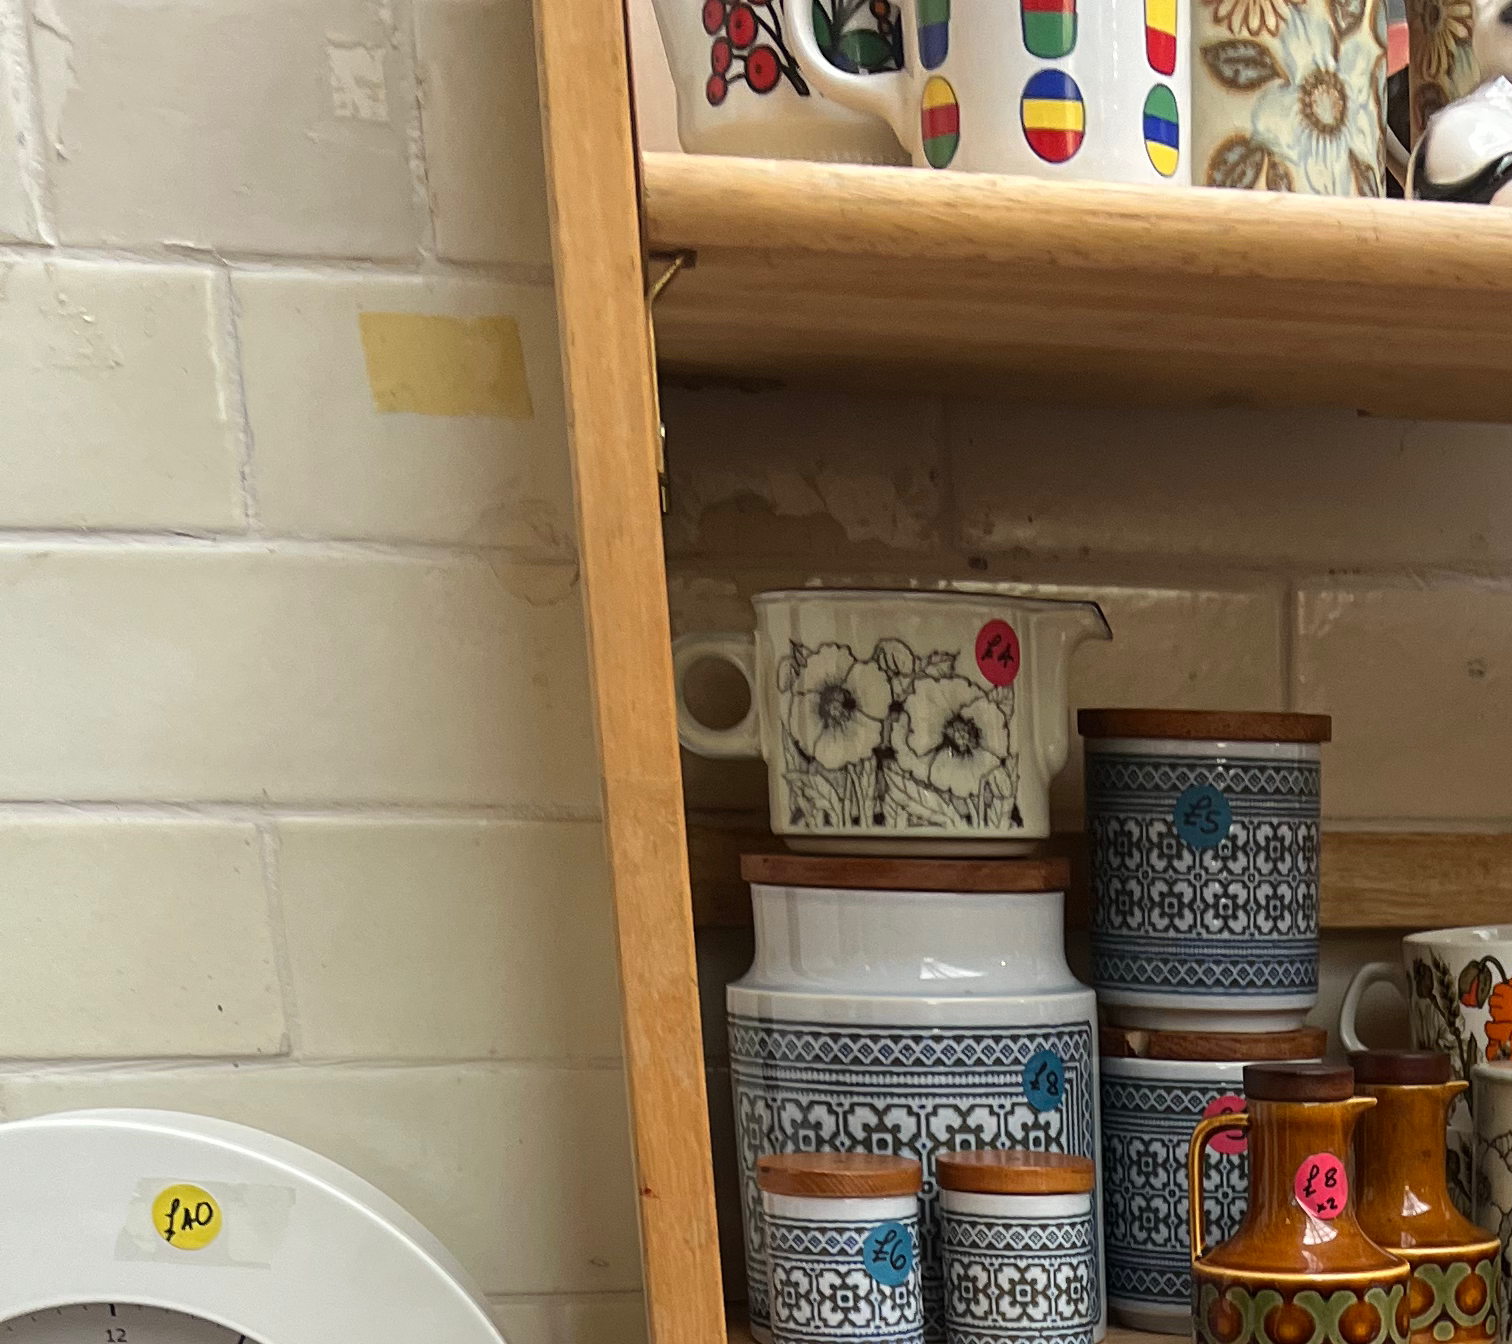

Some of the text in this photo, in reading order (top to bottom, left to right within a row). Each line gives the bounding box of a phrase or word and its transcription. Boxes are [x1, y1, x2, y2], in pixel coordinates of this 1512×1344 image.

[982, 634, 1014, 669] £4
[1184, 795, 1221, 834] £5
[1030, 1061, 1059, 1096] £8
[1303, 1164, 1338, 1198] £8
[872, 1229, 907, 1270] £6
[106, 1328, 128, 1343] 12
